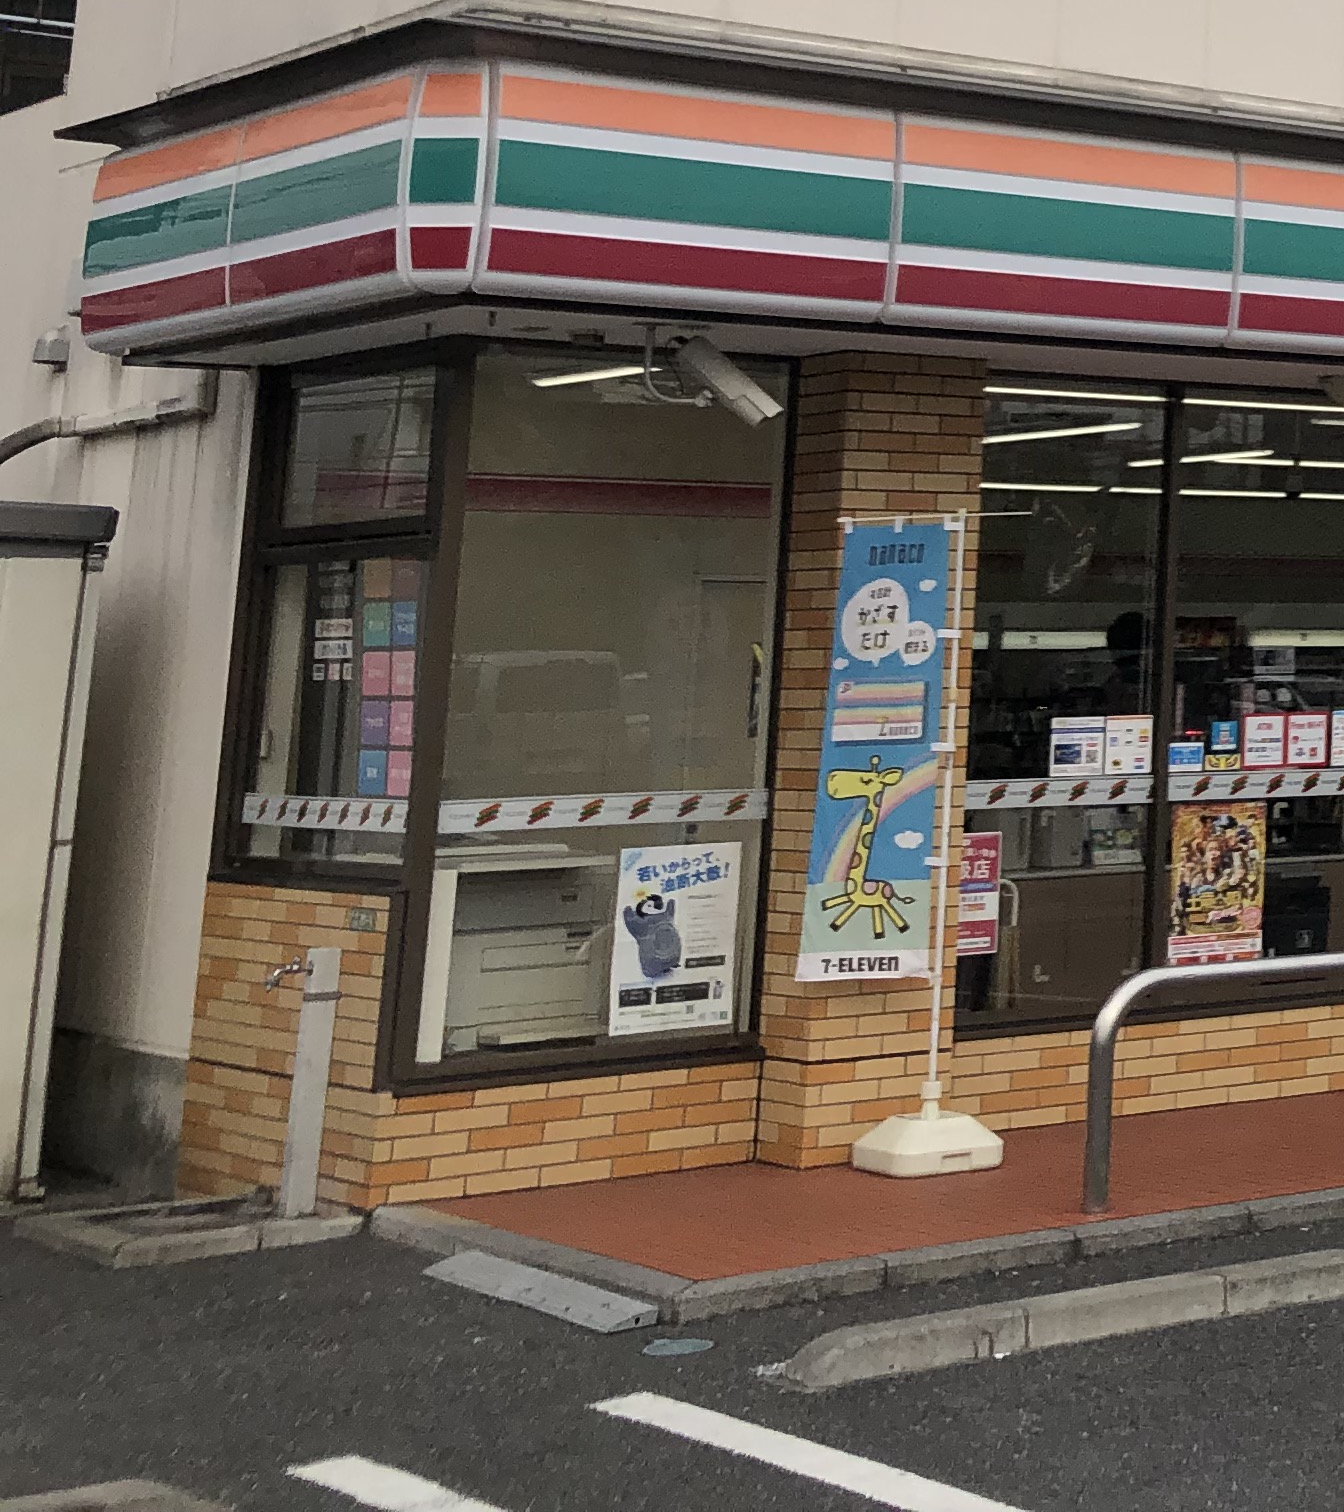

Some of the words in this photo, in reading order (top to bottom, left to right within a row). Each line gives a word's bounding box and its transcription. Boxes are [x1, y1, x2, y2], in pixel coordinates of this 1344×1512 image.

[868, 543, 925, 566] nanaco
[858, 603, 899, 626] かざす
